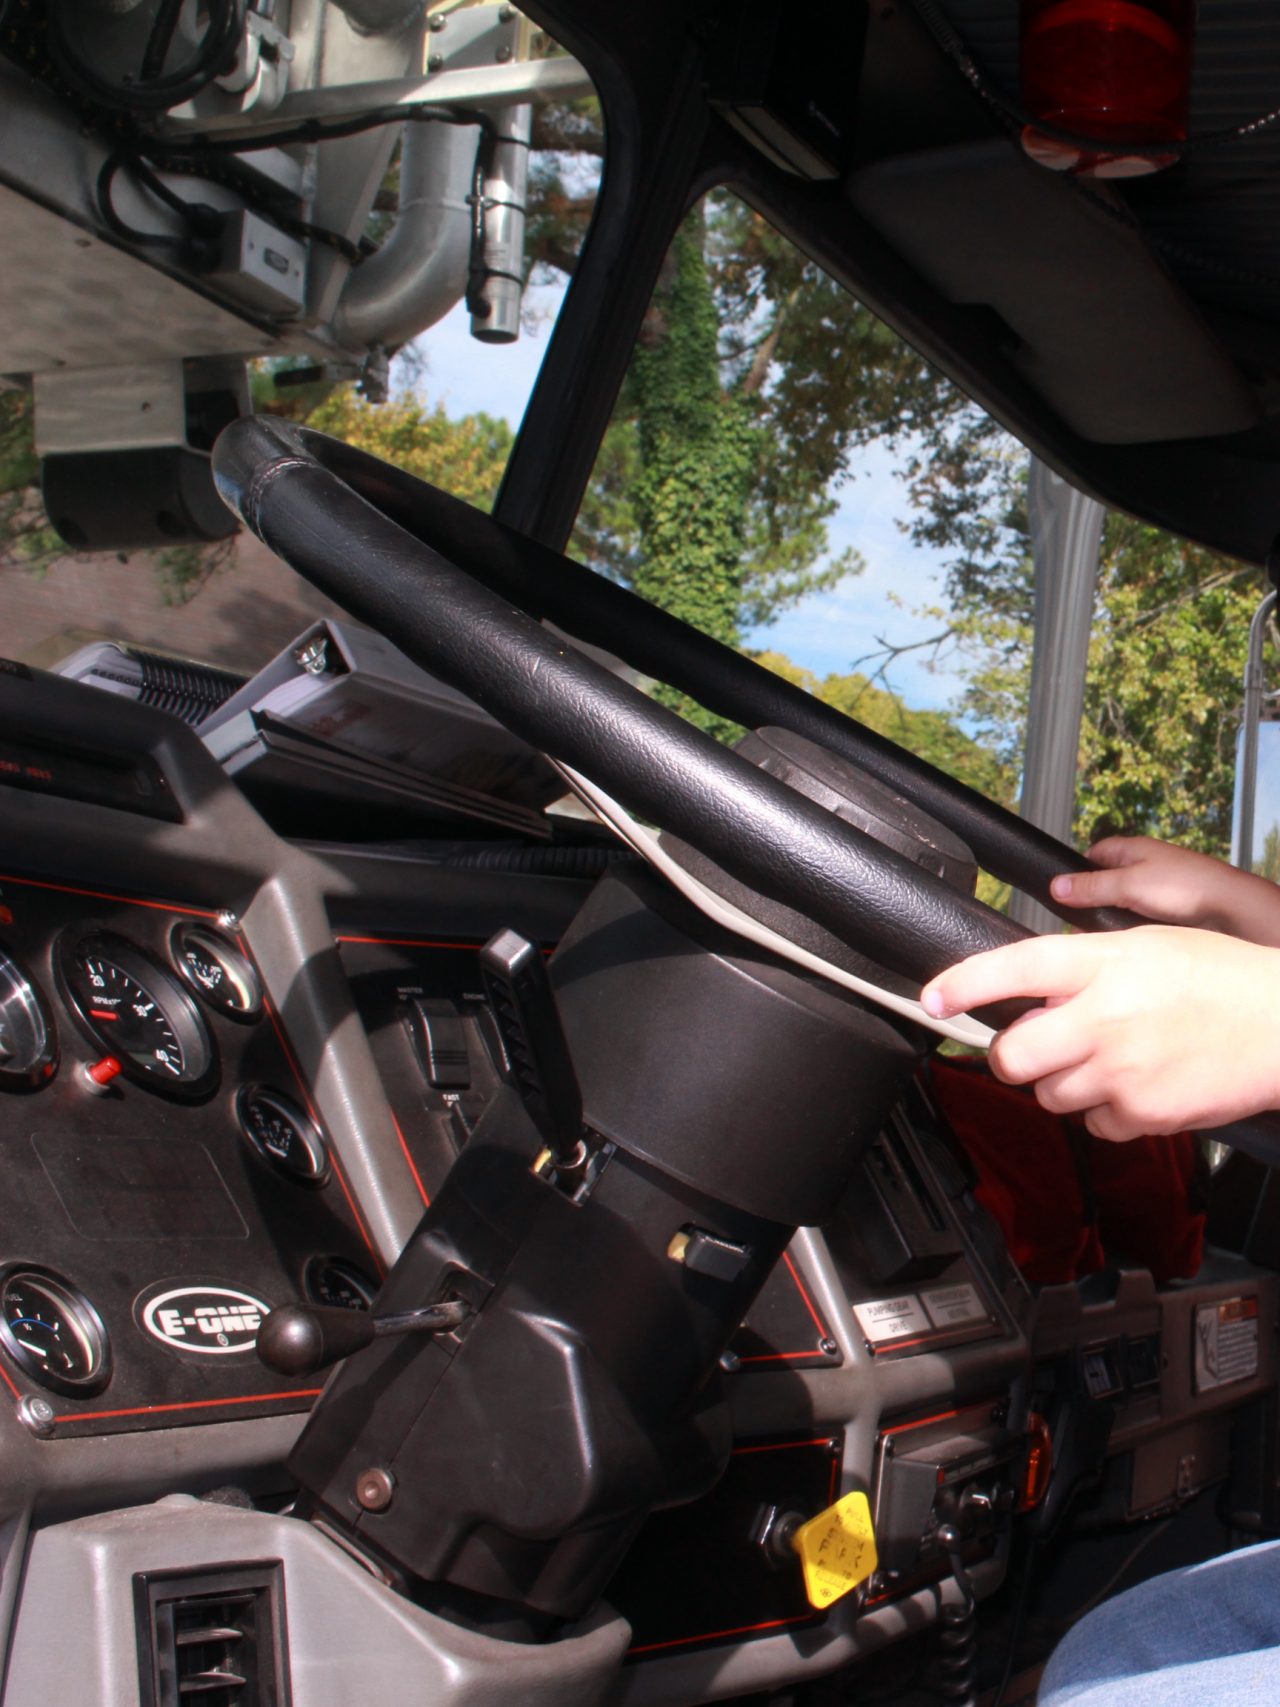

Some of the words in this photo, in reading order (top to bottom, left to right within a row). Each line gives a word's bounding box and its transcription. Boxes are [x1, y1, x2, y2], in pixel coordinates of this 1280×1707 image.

[90, 973, 105, 987] 20
[155, 1048, 169, 1062] 40
[158, 1305, 260, 1336] E-ONE
